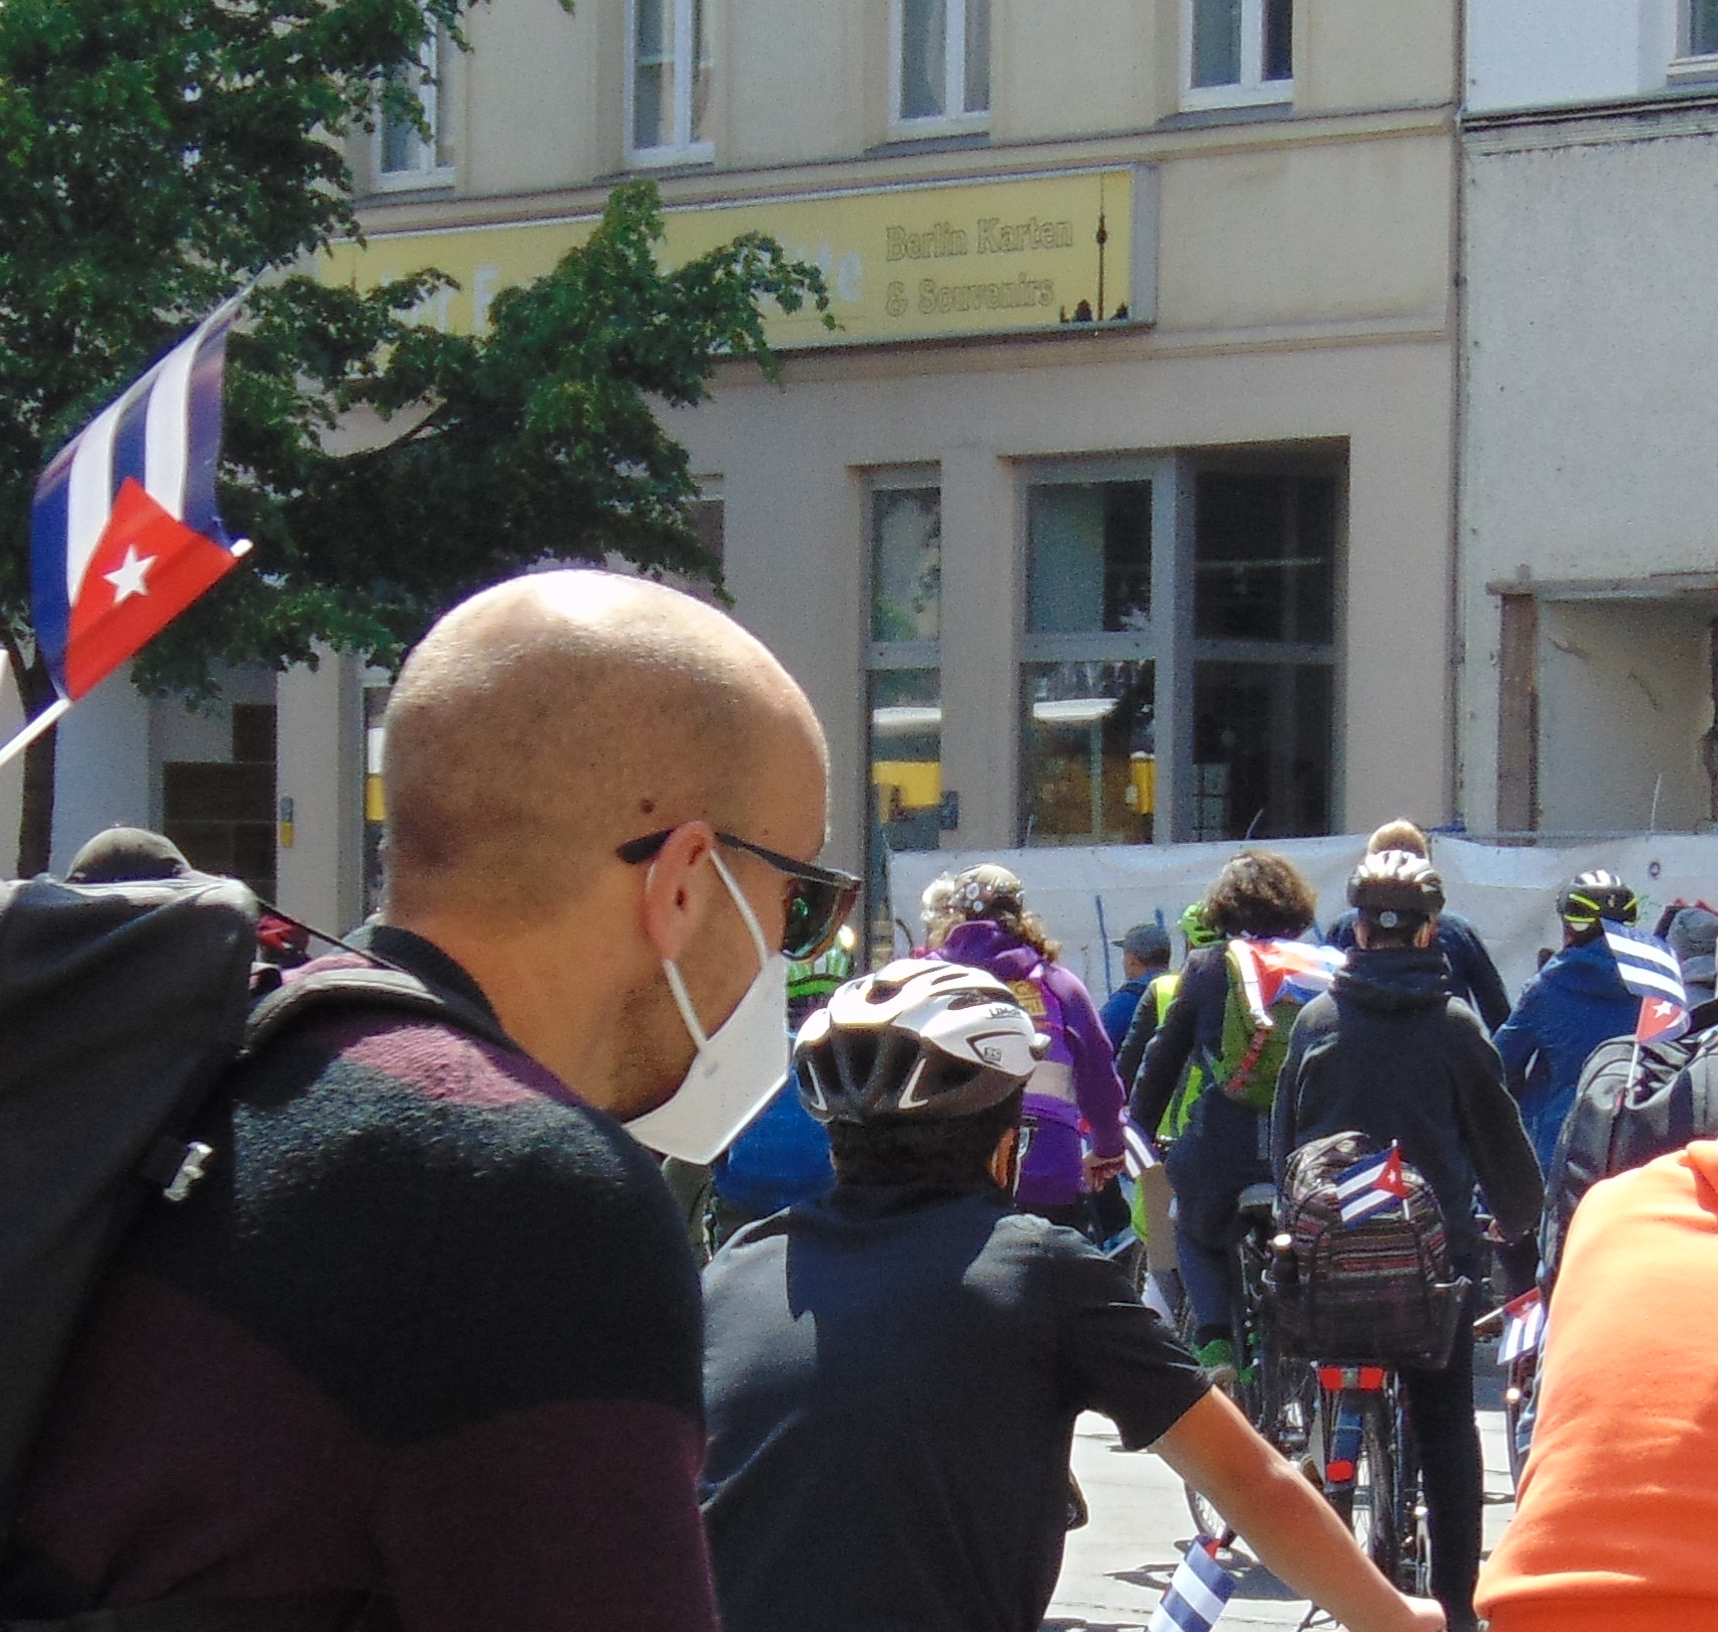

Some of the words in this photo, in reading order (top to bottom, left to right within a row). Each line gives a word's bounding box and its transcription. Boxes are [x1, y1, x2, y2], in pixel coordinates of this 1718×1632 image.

[886, 222, 968, 261] Berlin
[977, 217, 1074, 254] Karten
[885, 280, 909, 317] &
[918, 272, 1055, 315] Souvenirs
